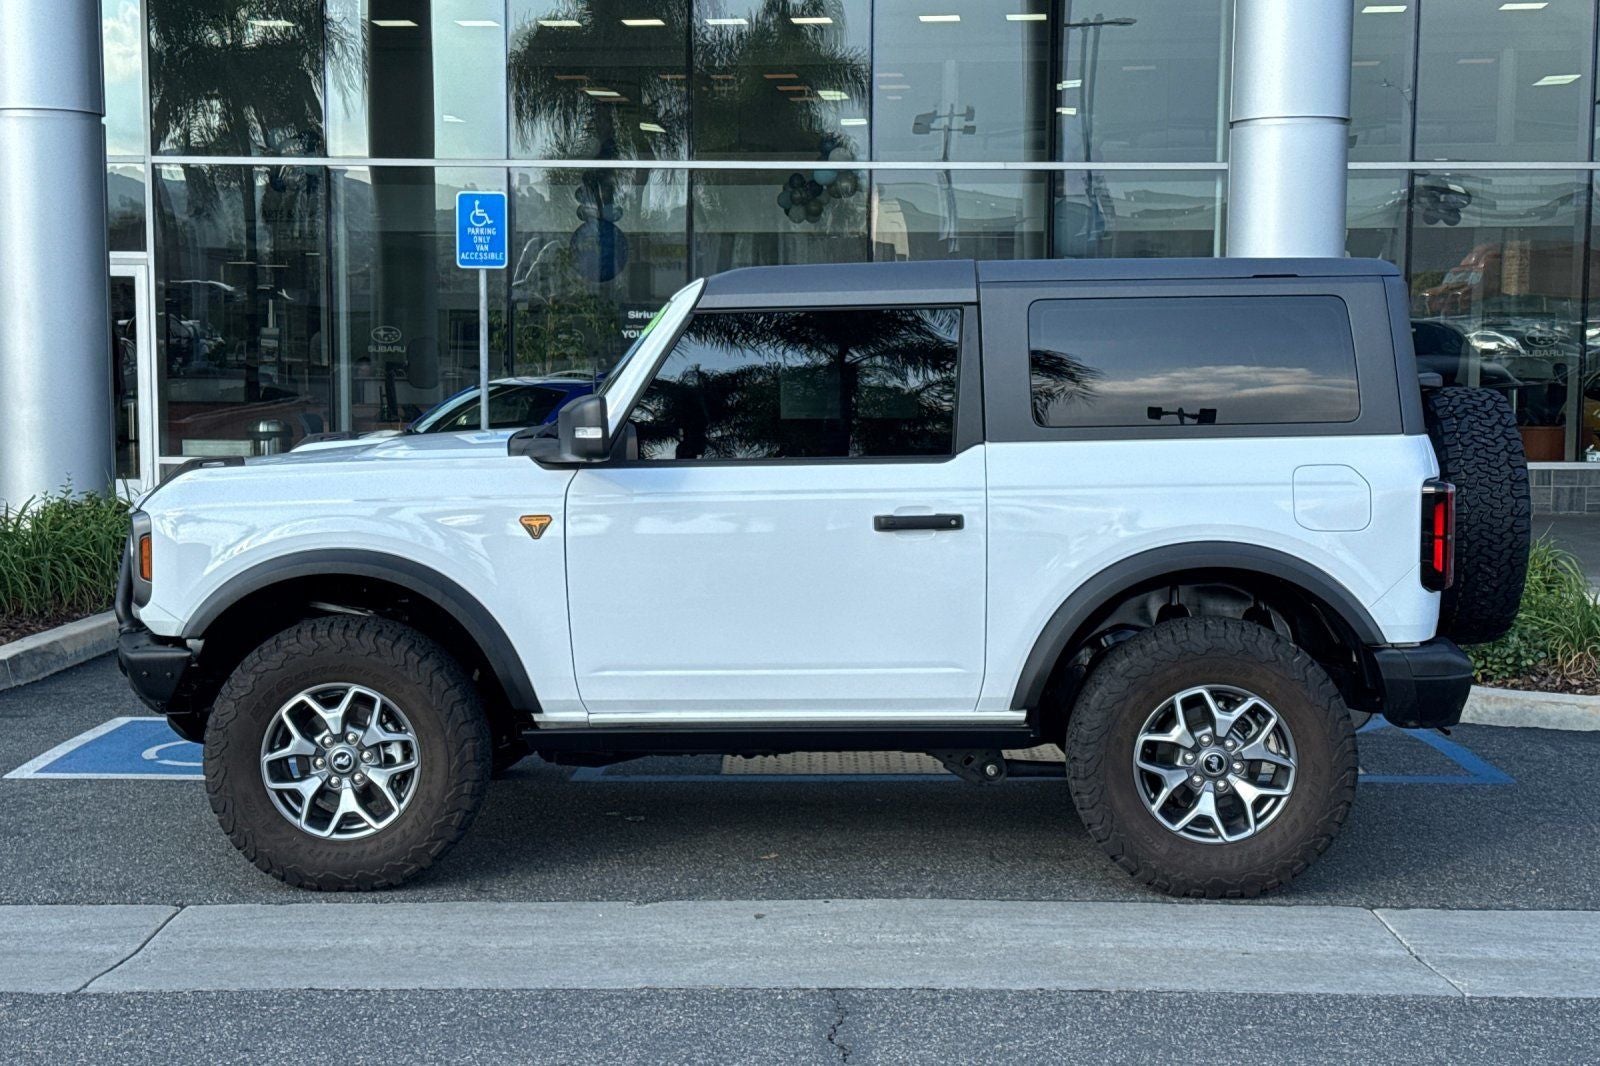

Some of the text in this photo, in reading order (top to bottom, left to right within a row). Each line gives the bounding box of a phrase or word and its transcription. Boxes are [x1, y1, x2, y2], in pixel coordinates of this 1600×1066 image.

[467, 227, 497, 235] PARKING
[473, 236, 491, 244] ONLY
[476, 244, 489, 252] VAN
[461, 252, 504, 260] ACCESSIBLE
[368, 345, 406, 353] SUBARU
